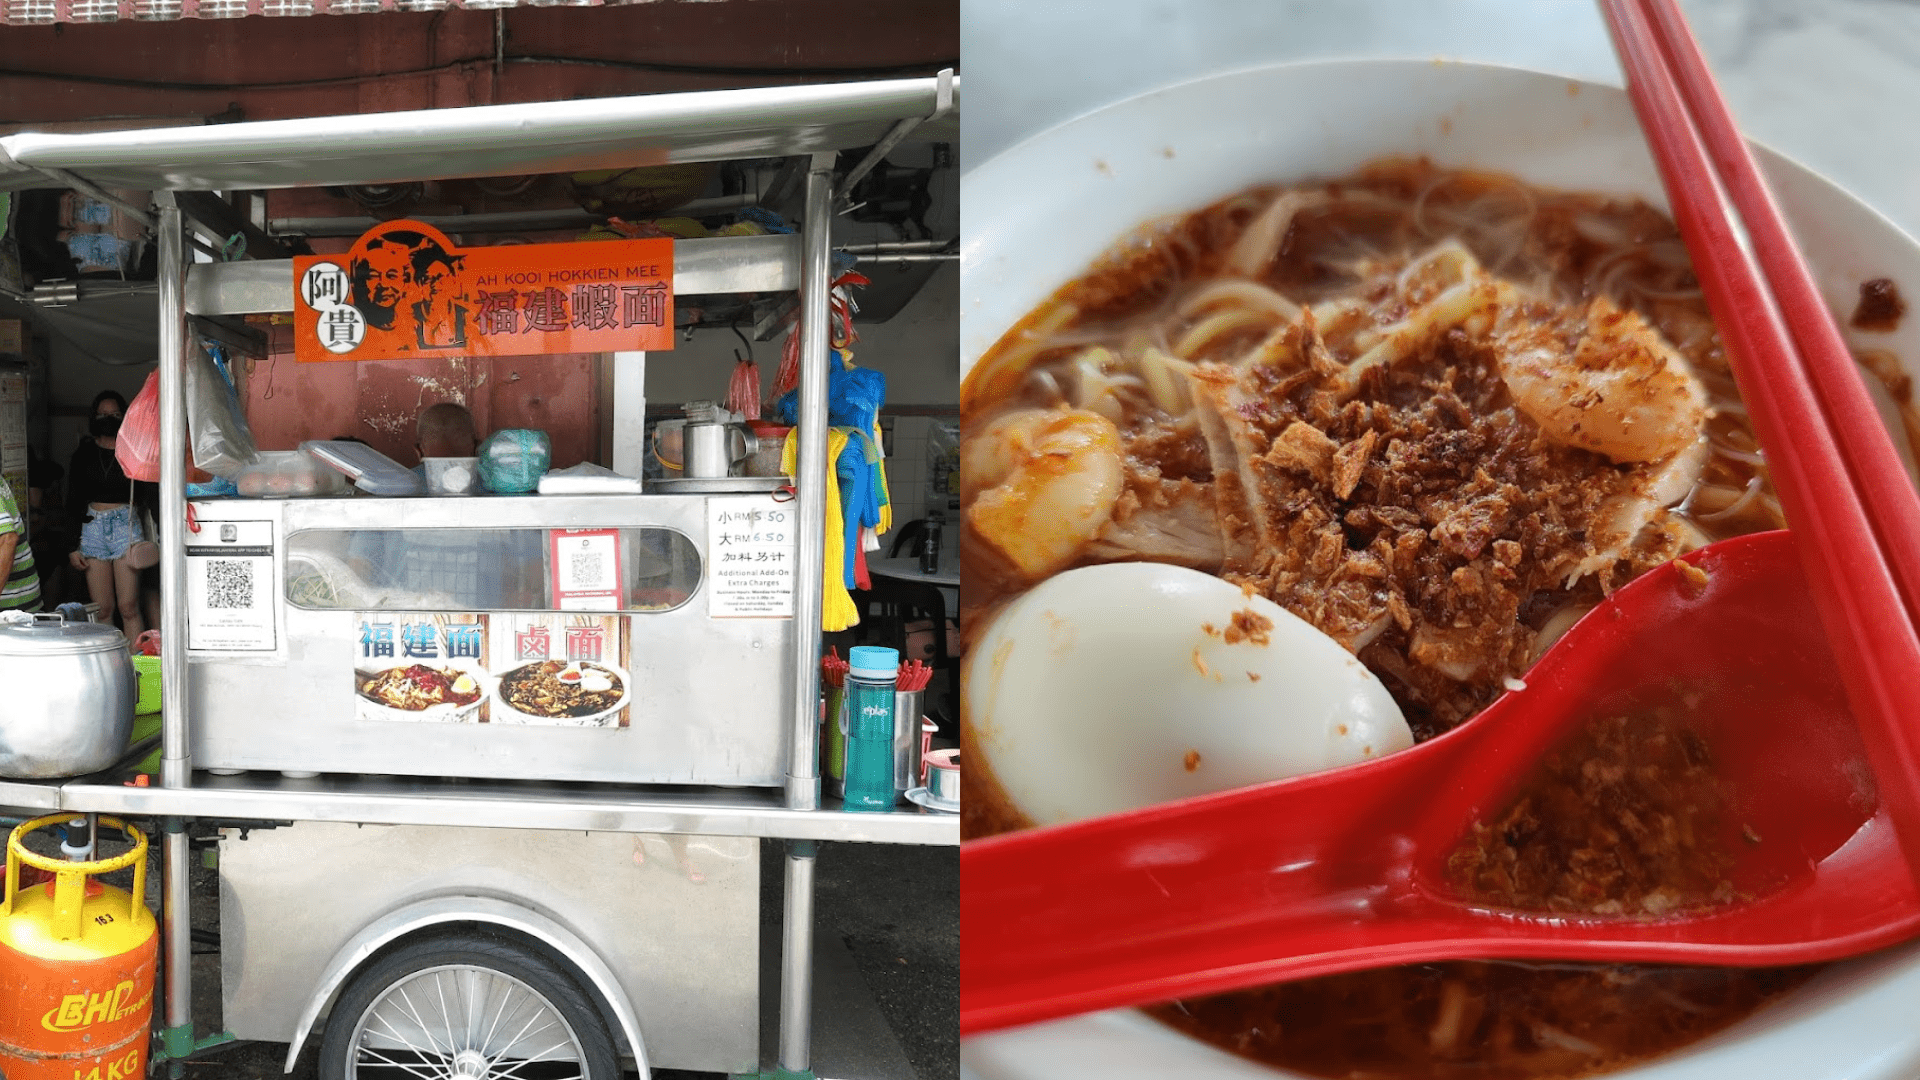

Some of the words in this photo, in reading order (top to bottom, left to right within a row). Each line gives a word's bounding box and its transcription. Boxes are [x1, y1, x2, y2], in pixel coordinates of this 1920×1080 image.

[476, 275, 497, 286] AH
[505, 272, 541, 285] KOOI
[549, 267, 619, 282] HOKKIEN
[626, 265, 660, 277] MEE
[473, 281, 668, 335] 福建蝦面
[718, 511, 732, 525] 小
[719, 532, 732, 545] 大
[359, 621, 482, 659] 福建面
